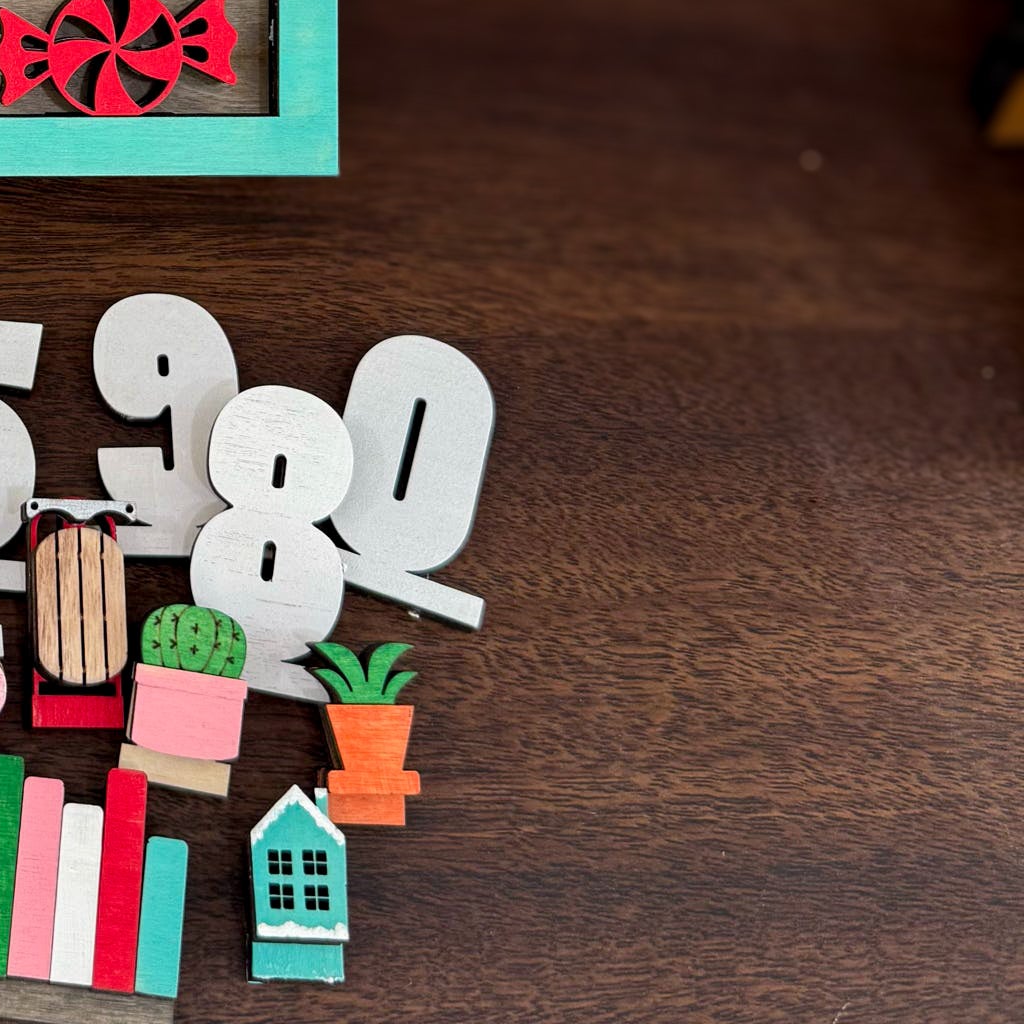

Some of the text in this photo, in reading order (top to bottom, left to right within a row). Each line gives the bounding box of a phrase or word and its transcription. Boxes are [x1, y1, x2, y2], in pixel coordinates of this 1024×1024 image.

[93, 293, 239, 528] 9
[190, 385, 354, 666] 8
[329, 335, 496, 573] 0
